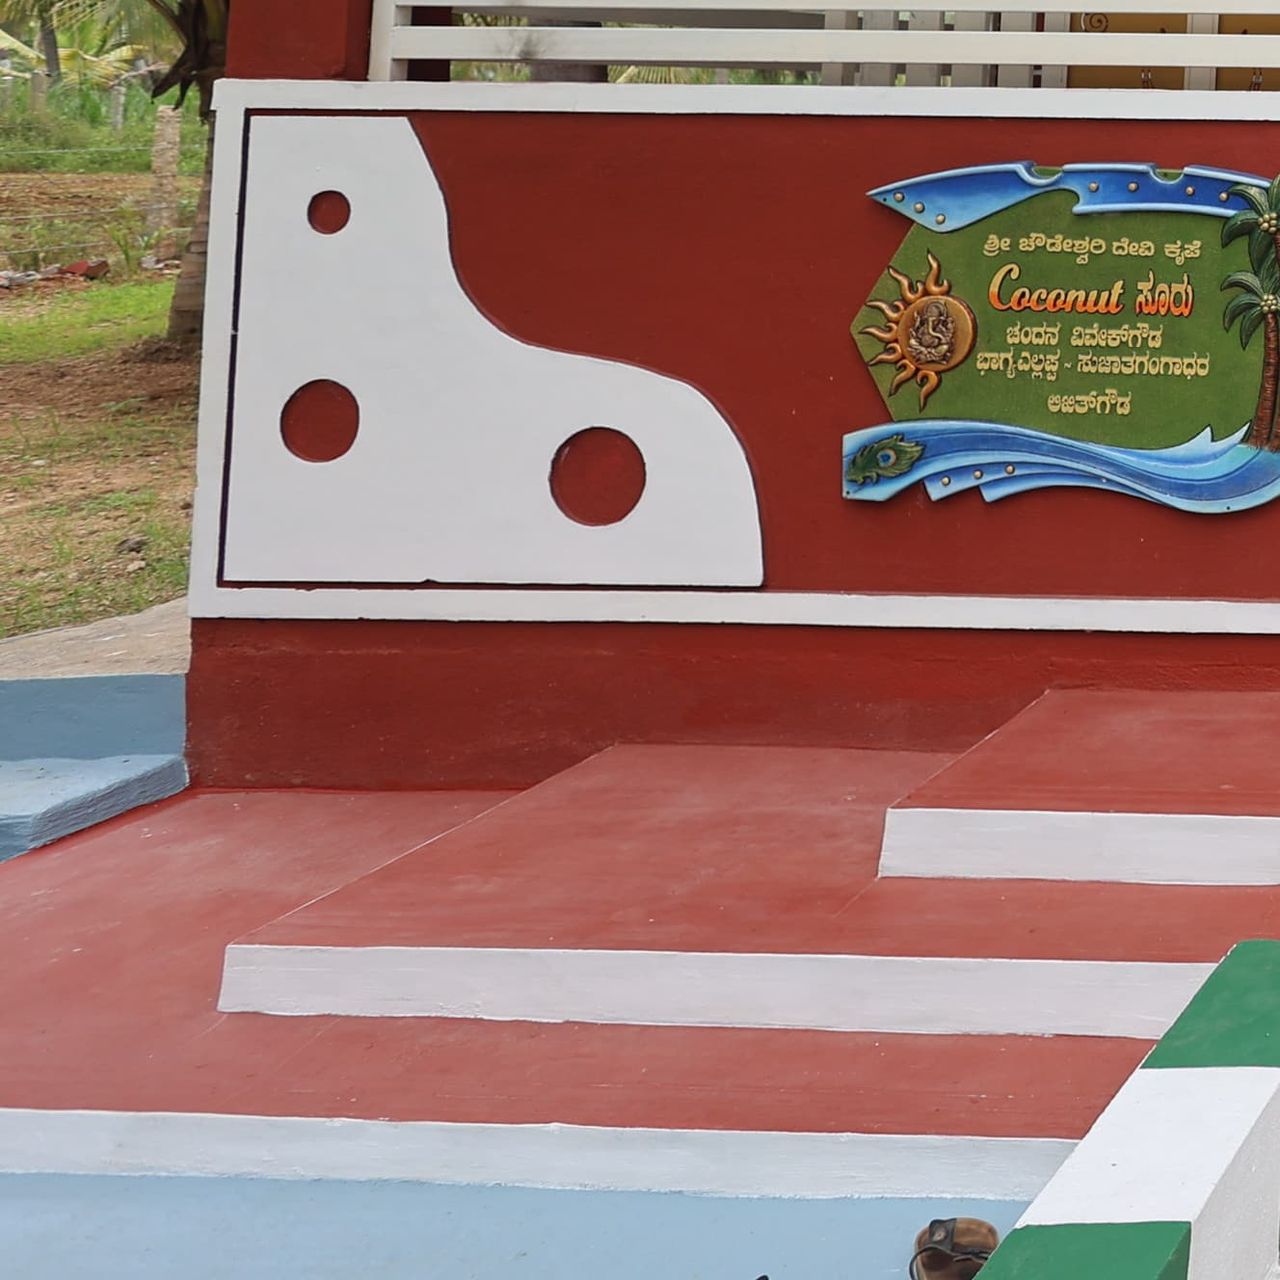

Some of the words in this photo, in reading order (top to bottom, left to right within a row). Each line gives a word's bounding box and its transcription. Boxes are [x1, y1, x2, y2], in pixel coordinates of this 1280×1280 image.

[983, 233, 1011, 256] ಶ್ರೀ
[1018, 232, 1106, 265] ಚೌಡೇಶ್ವರಿ
[1112, 236, 1155, 258] ದೇವಿ
[1164, 239, 1202, 266] ಕೃಪೆ
[988, 262, 1126, 315] Coconut
[1135, 270, 1195, 318] ಸೂರು
[1006, 321, 1062, 347] ಚಂದನ
